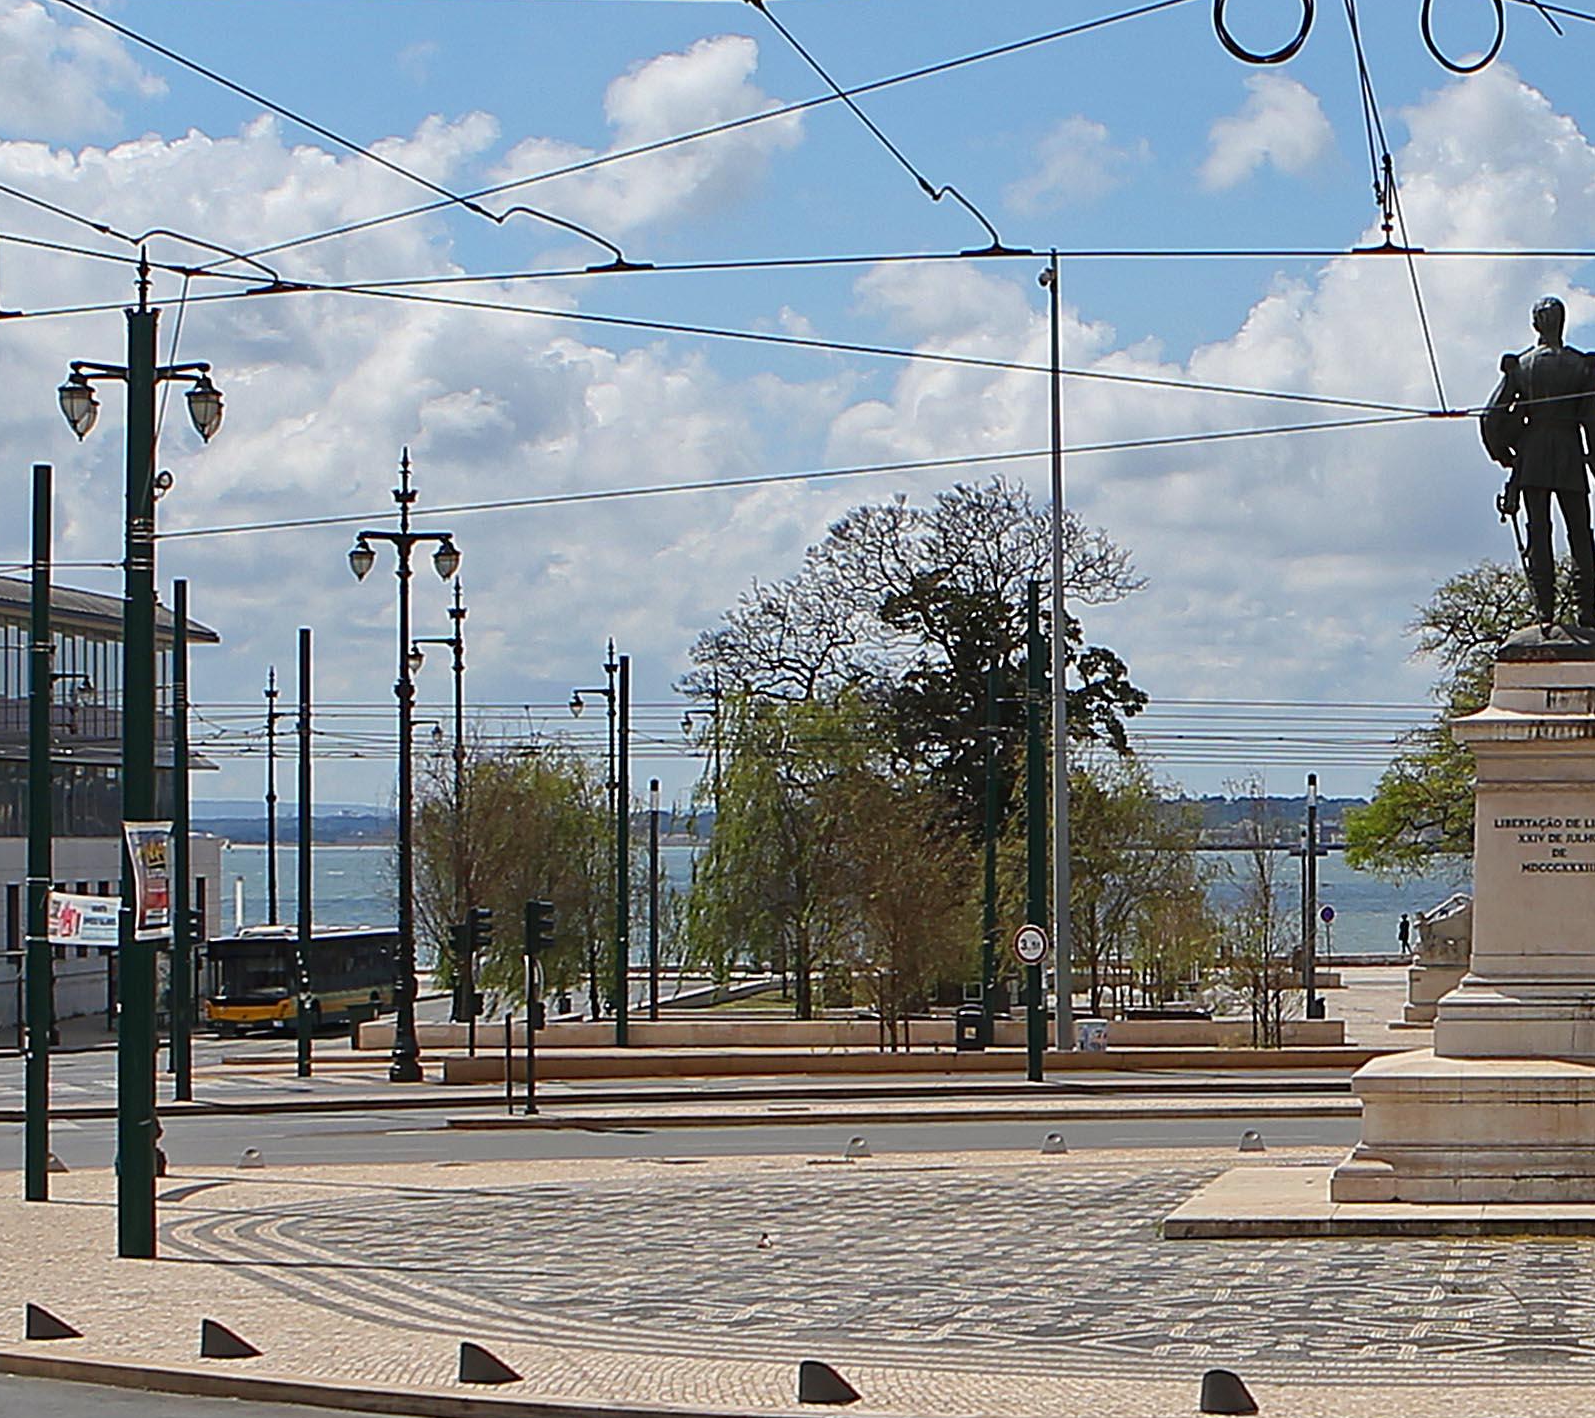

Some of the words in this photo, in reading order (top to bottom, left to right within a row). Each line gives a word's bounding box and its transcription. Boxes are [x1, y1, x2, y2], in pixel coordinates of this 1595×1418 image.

[1494, 818, 1563, 831] LIBERTAÇÃO
[1565, 819, 1582, 829] DE
[1518, 833, 1546, 843] XXIV
[1548, 833, 1563, 843] DE
[1551, 848, 1567, 858] DE
